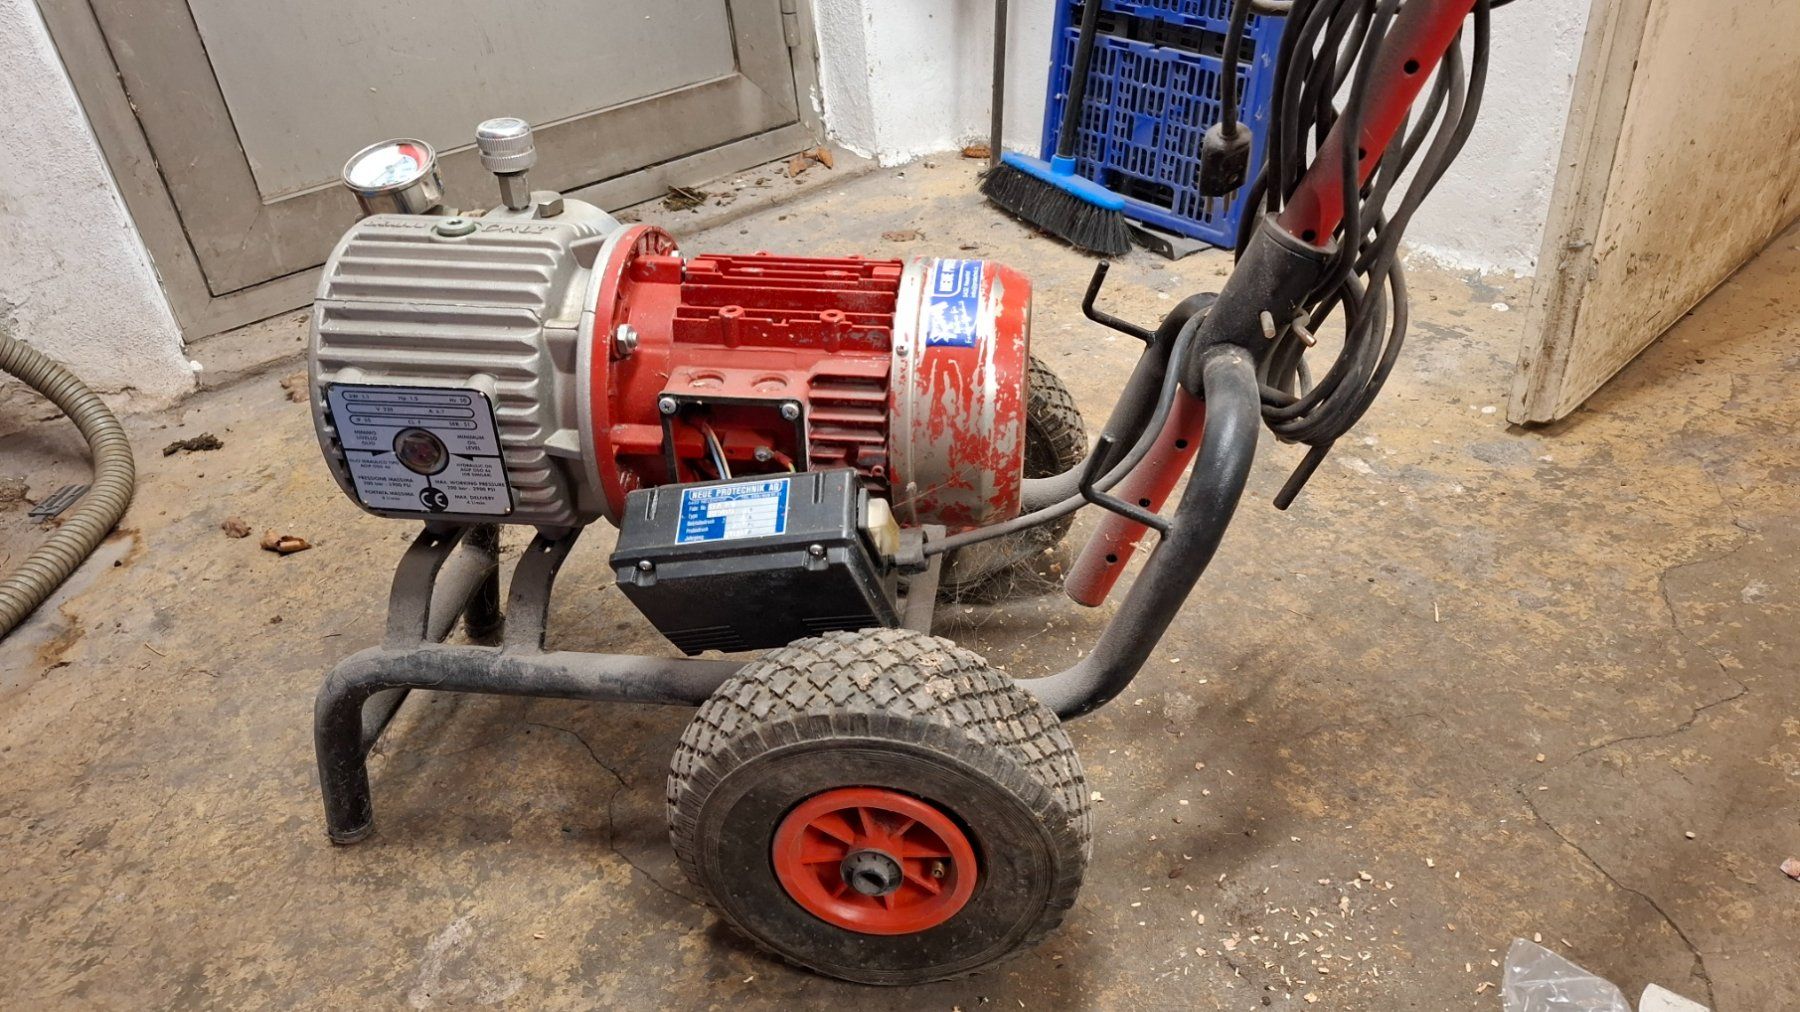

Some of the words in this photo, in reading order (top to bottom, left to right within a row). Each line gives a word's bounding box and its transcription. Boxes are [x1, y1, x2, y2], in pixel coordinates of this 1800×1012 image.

[691, 489, 713, 499] NEUE
[716, 483, 765, 496] PROTECHNIK
[421, 491, 447, 508] CE
